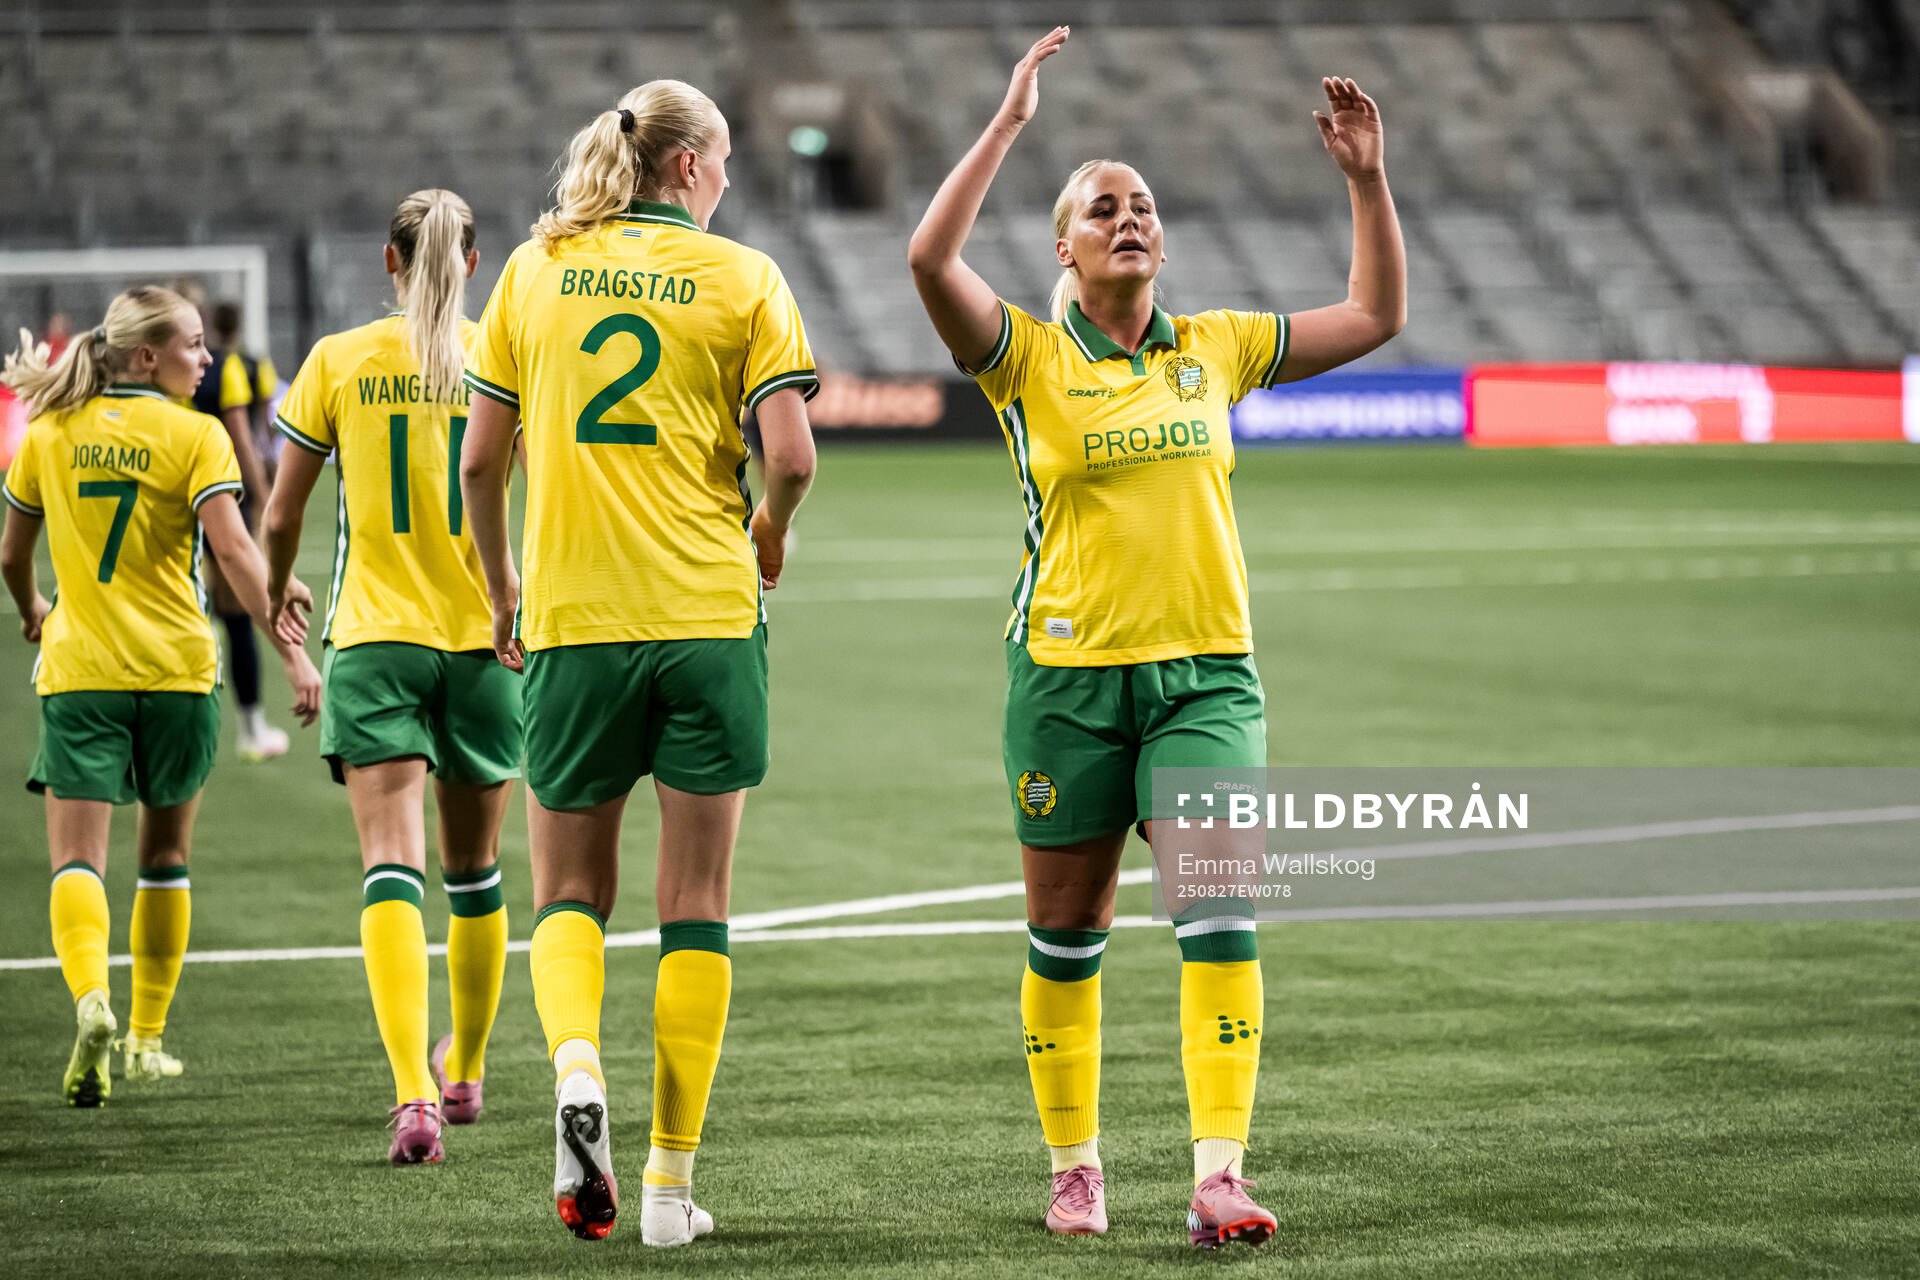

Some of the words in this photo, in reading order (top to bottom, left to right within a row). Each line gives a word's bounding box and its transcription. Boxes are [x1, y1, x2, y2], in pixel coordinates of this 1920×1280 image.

[560, 268, 697, 306] BRAGSTAD
[575, 312, 661, 445] 2
[1067, 388, 1108, 398] CRAFT
[70, 444, 151, 472] JORAMO
[1084, 419, 1210, 461] PROJOB
[388, 413, 470, 536] 11
[1087, 455, 1159, 471] PROFESSIONAL
[1160, 449, 1212, 461] WORKWEAR
[78, 481, 139, 583] 7
[1213, 781, 1252, 792] CRAFT
